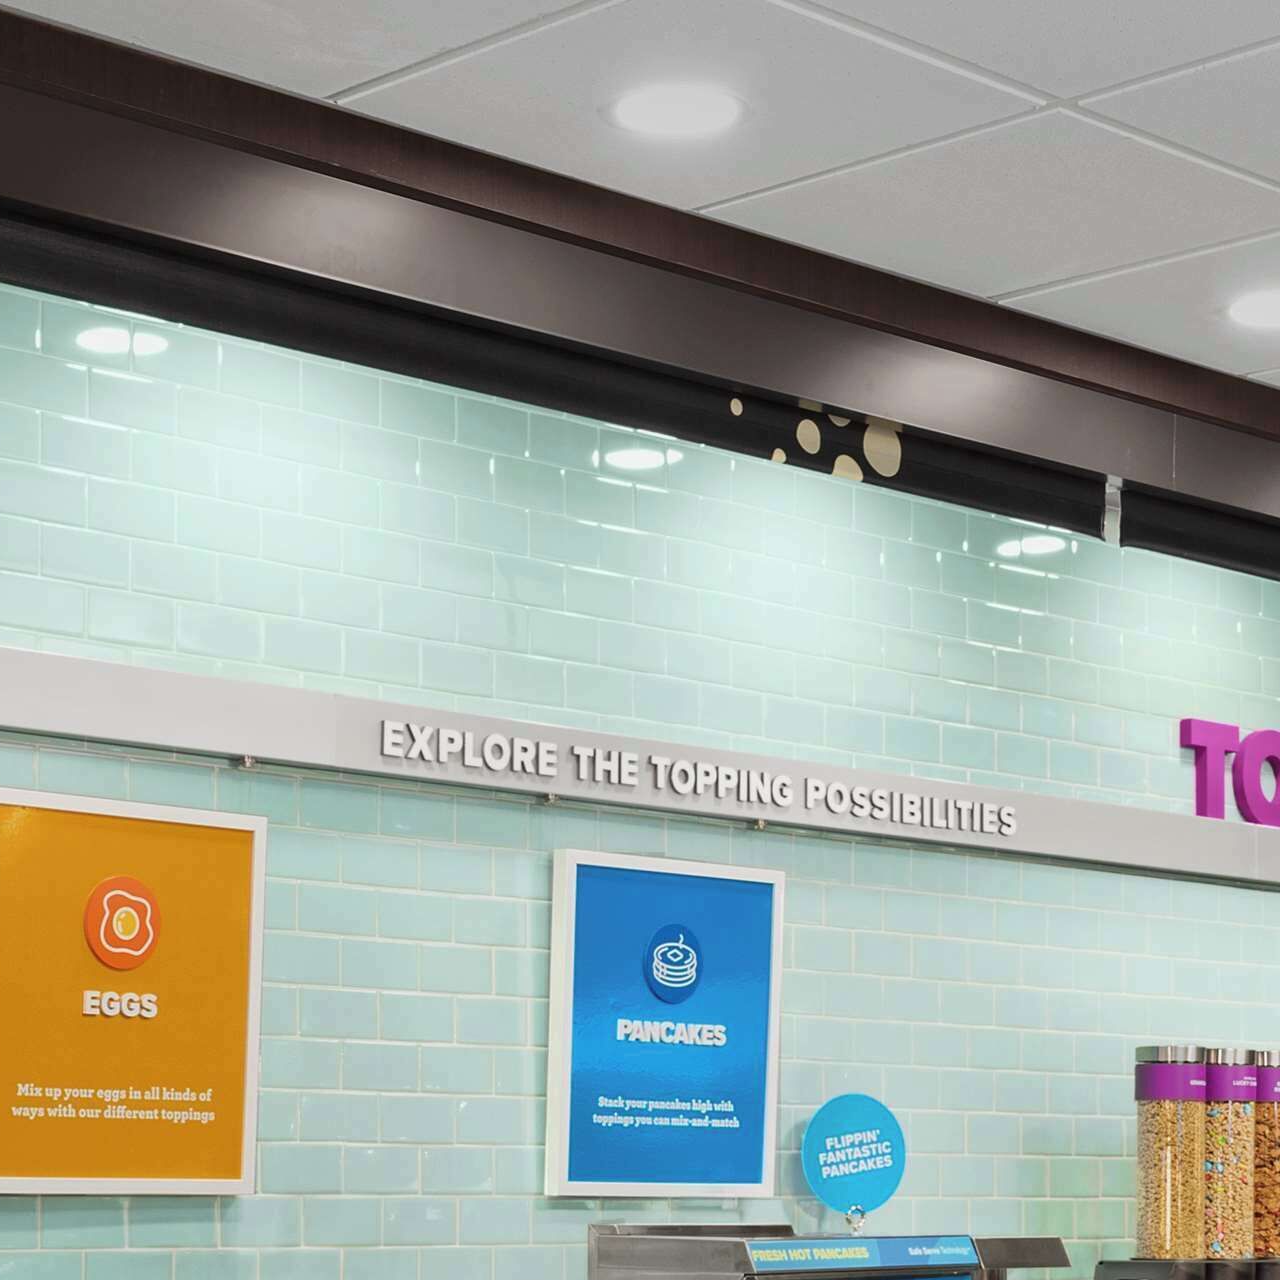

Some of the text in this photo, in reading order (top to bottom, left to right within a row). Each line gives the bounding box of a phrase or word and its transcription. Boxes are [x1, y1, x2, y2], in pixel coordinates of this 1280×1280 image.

[380, 719, 1017, 836] EXPLORE THE TOPPING POSSIBILITIES
[82, 990, 158, 1018] EGGS
[617, 1018, 727, 1047] PANCAKES
[16, 1083, 213, 1102] Mix up your eggs in all kinds of
[11, 1104, 215, 1124] ways with our different toppings
[598, 1096, 734, 1113] Stack your pancakes high with
[592, 1112, 634, 1127] toppings
[635, 1116, 652, 1127] you
[653, 1117, 670, 1126] can
[825, 1129, 880, 1150] FLIPPIN'
[818, 1141, 892, 1166] FANTASTIC
[822, 1155, 893, 1179] PANCAKES
[752, 1247, 869, 1262] FRESH HOT PANCAKES
